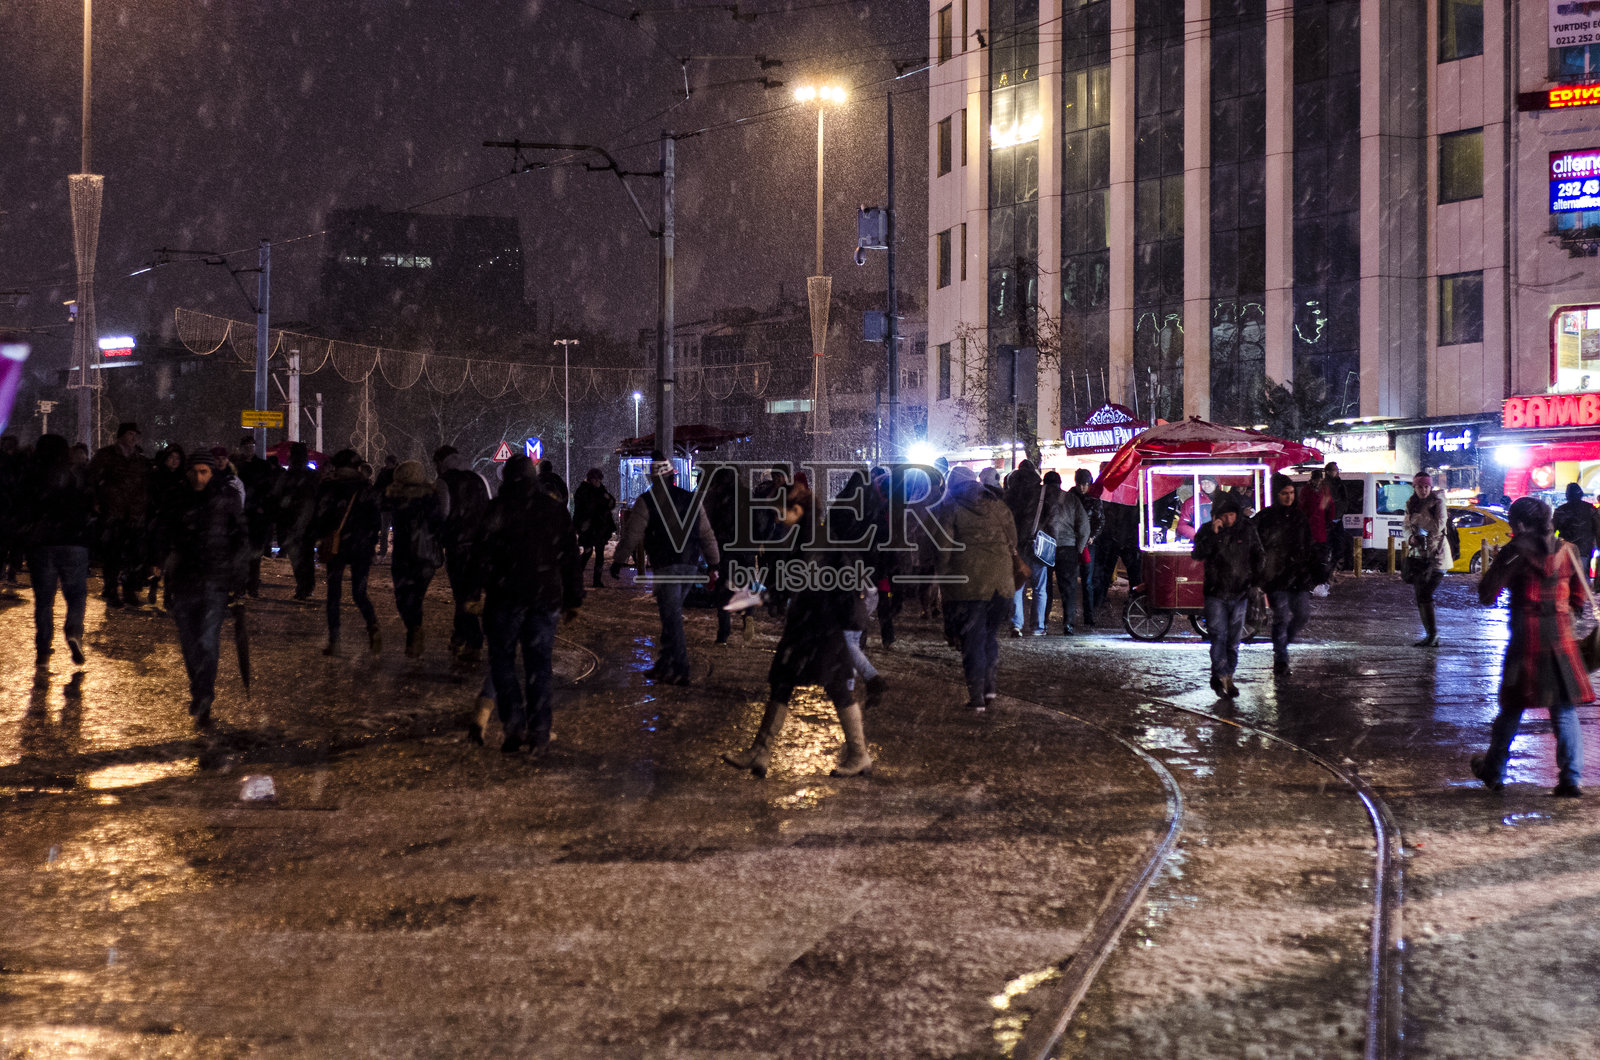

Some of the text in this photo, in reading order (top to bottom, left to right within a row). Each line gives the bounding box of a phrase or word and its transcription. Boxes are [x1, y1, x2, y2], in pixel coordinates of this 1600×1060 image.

[1553, 21, 1591, 32] YURTDIŞI
[1556, 36, 1576, 45] 0212
[1578, 34, 1593, 43] 252
[1558, 182, 1581, 197] 292
[1065, 430, 1113, 448] OTTOMAN
